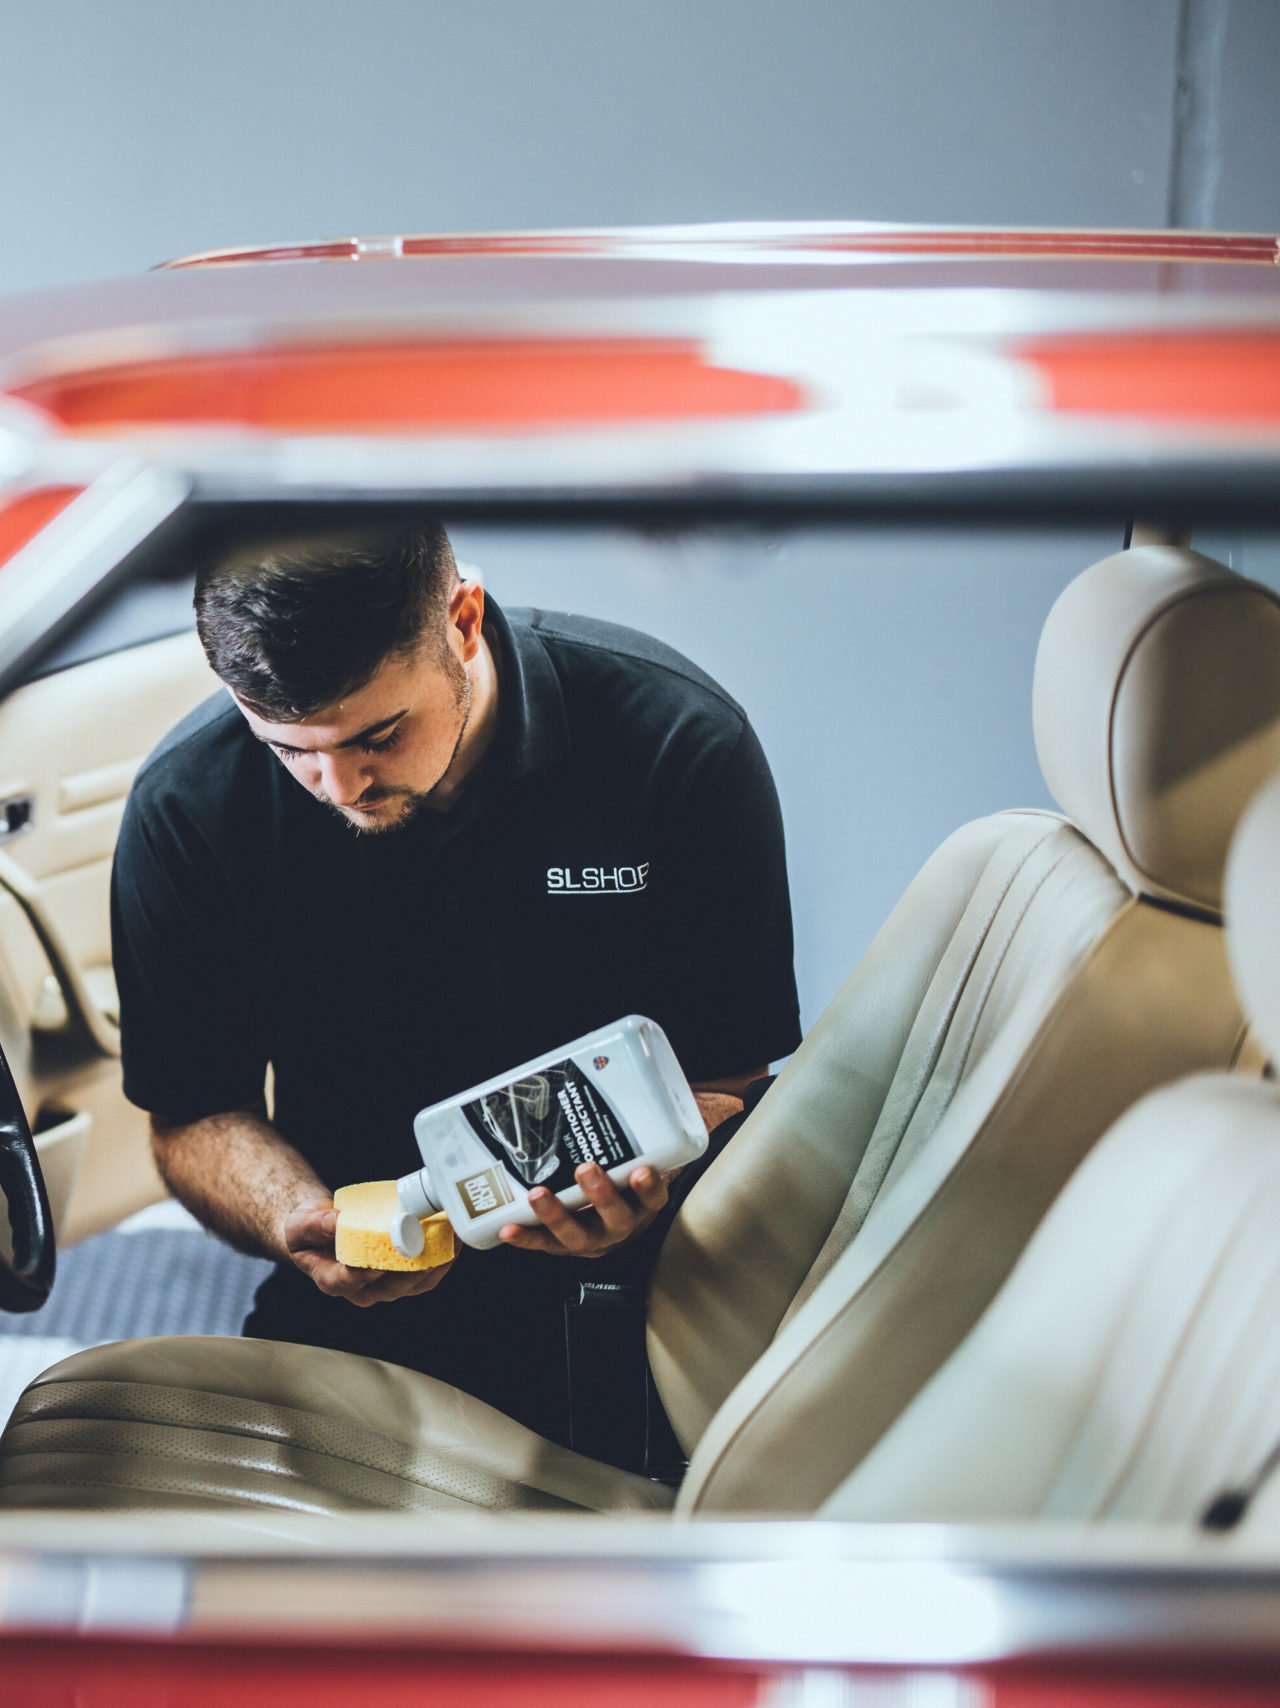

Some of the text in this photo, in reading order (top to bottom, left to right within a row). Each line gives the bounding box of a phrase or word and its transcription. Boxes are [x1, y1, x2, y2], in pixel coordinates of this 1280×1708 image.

[557, 1089, 595, 1164] ONDITIONER
[565, 1081, 603, 1156] PROTECTANT
[563, 1133, 582, 1164] ATHER
[599, 1156, 608, 1165] &
